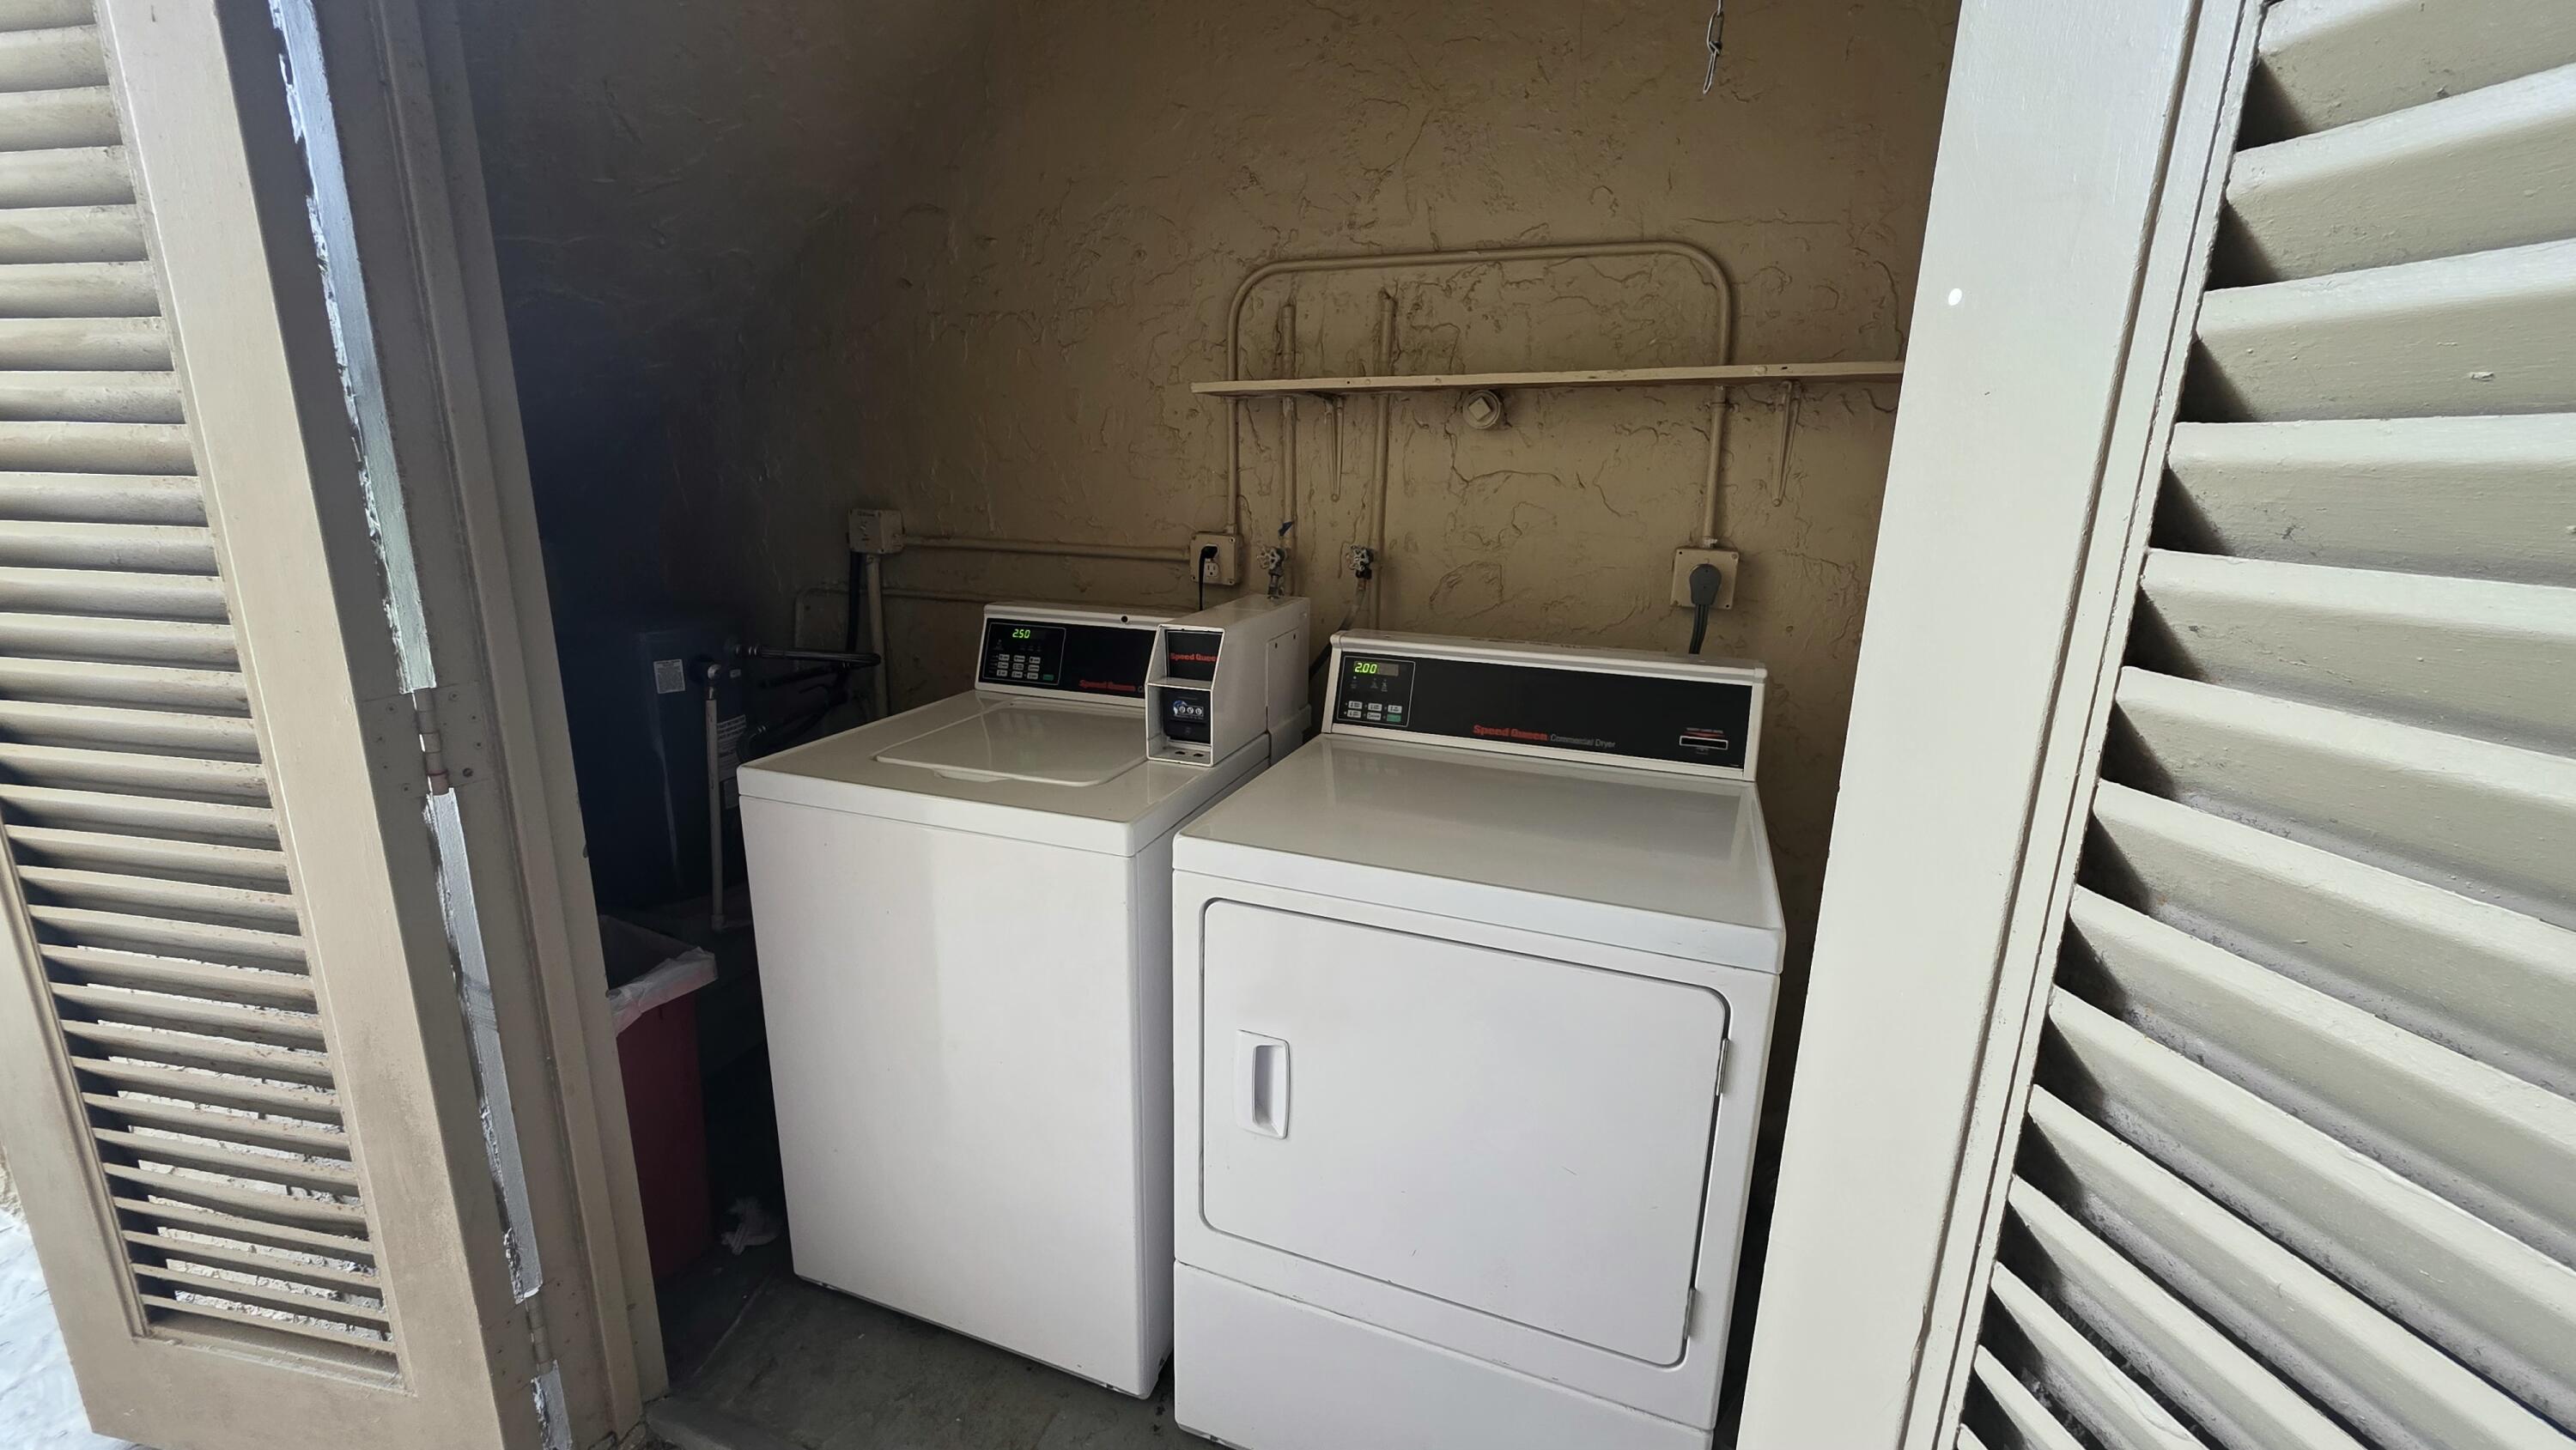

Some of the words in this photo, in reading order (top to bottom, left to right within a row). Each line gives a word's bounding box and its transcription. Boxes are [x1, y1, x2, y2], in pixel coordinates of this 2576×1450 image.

[1354, 662, 1377, 674] 2.00
[1473, 725, 1510, 736] Speed
[1595, 739, 1616, 749] Dryer
